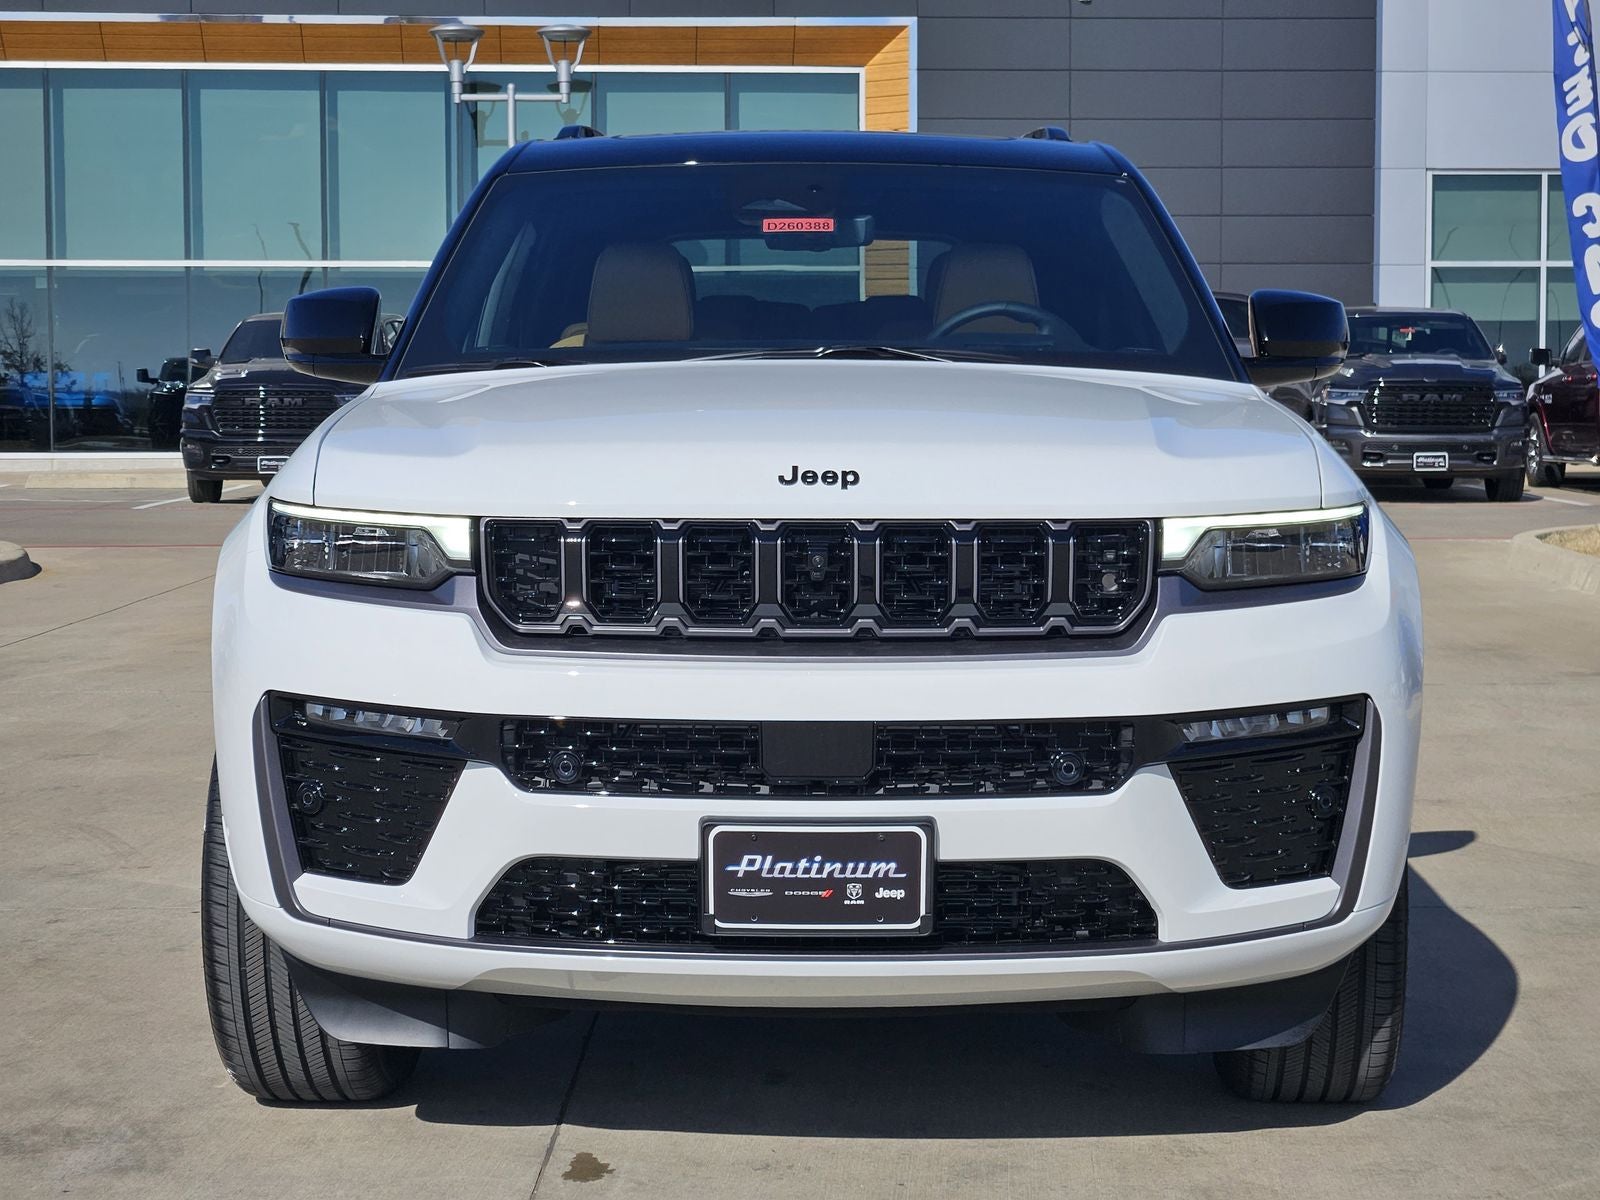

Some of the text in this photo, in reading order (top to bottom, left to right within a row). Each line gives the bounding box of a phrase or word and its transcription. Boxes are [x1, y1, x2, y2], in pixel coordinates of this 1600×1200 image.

[767, 222, 830, 231] D260388
[1402, 393, 1463, 402] RAM
[778, 465, 860, 490] Jeep
[725, 854, 907, 878] Platinum
[875, 887, 905, 900] Jeep
